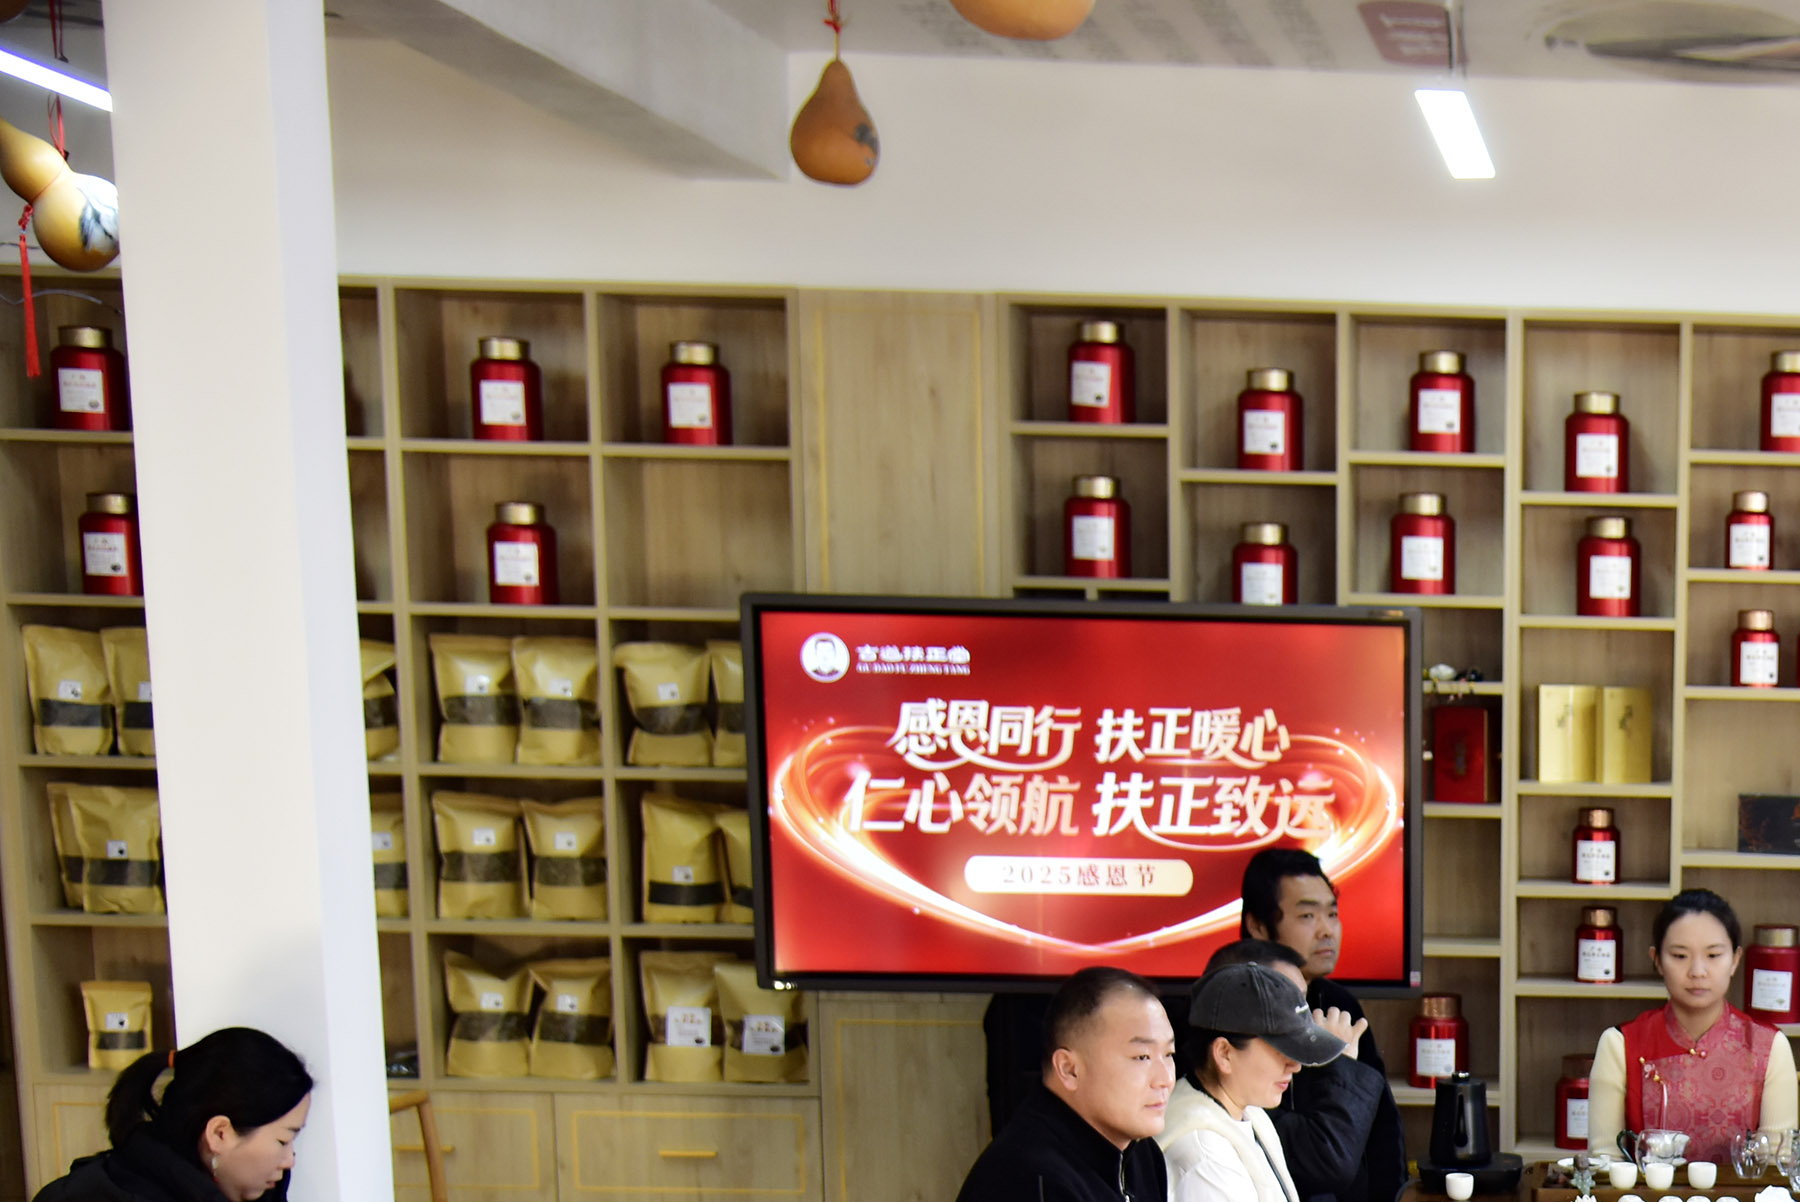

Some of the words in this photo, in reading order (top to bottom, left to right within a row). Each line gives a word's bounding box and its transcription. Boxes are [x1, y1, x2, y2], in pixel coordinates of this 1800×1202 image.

[886, 697, 1082, 772] 感恩同行
[1094, 706, 1291, 770] 扶正暖心
[845, 771, 1081, 836] 仁心领航
[1092, 771, 1336, 852] 扶正致远
[1002, 863, 1156, 888] 2025感恩节
